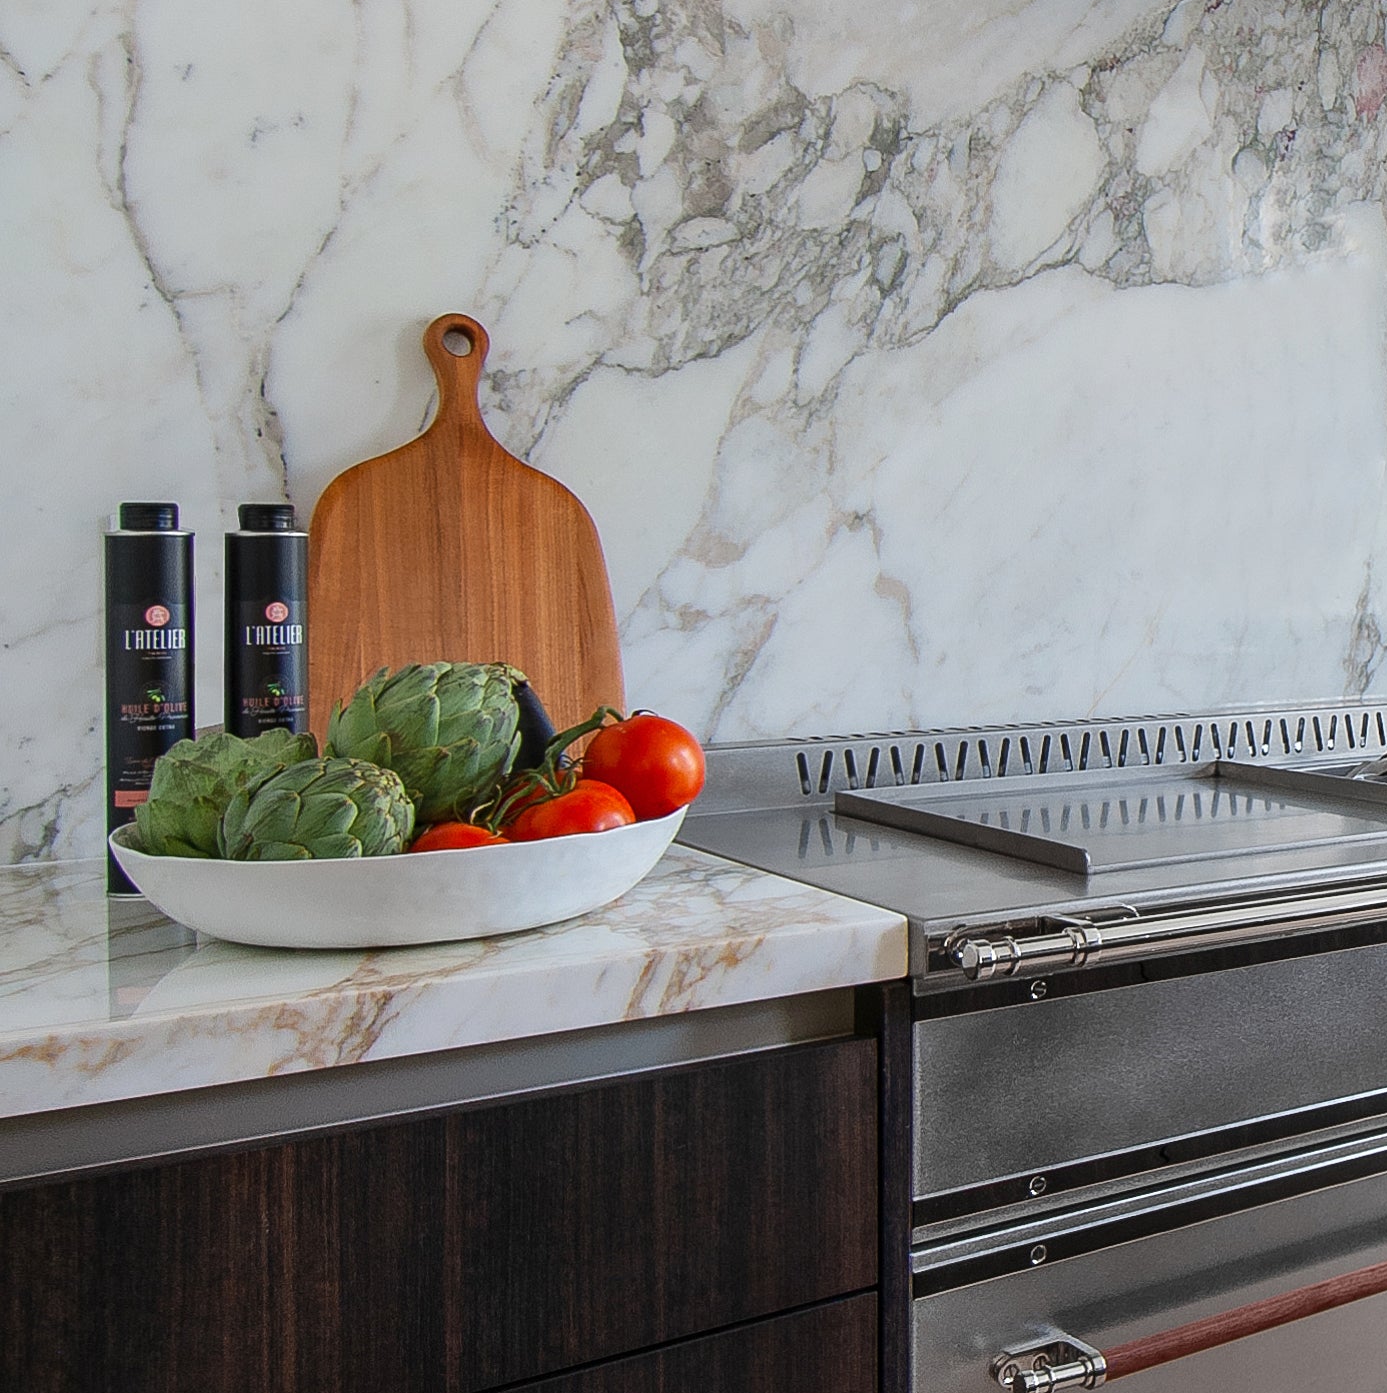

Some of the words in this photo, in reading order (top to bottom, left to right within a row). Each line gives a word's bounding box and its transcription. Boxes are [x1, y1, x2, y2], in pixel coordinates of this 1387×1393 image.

[125, 628, 186, 650] L'ATELIER
[246, 624, 303, 645] L'ATELIER
[121, 703, 149, 714] HUILE
